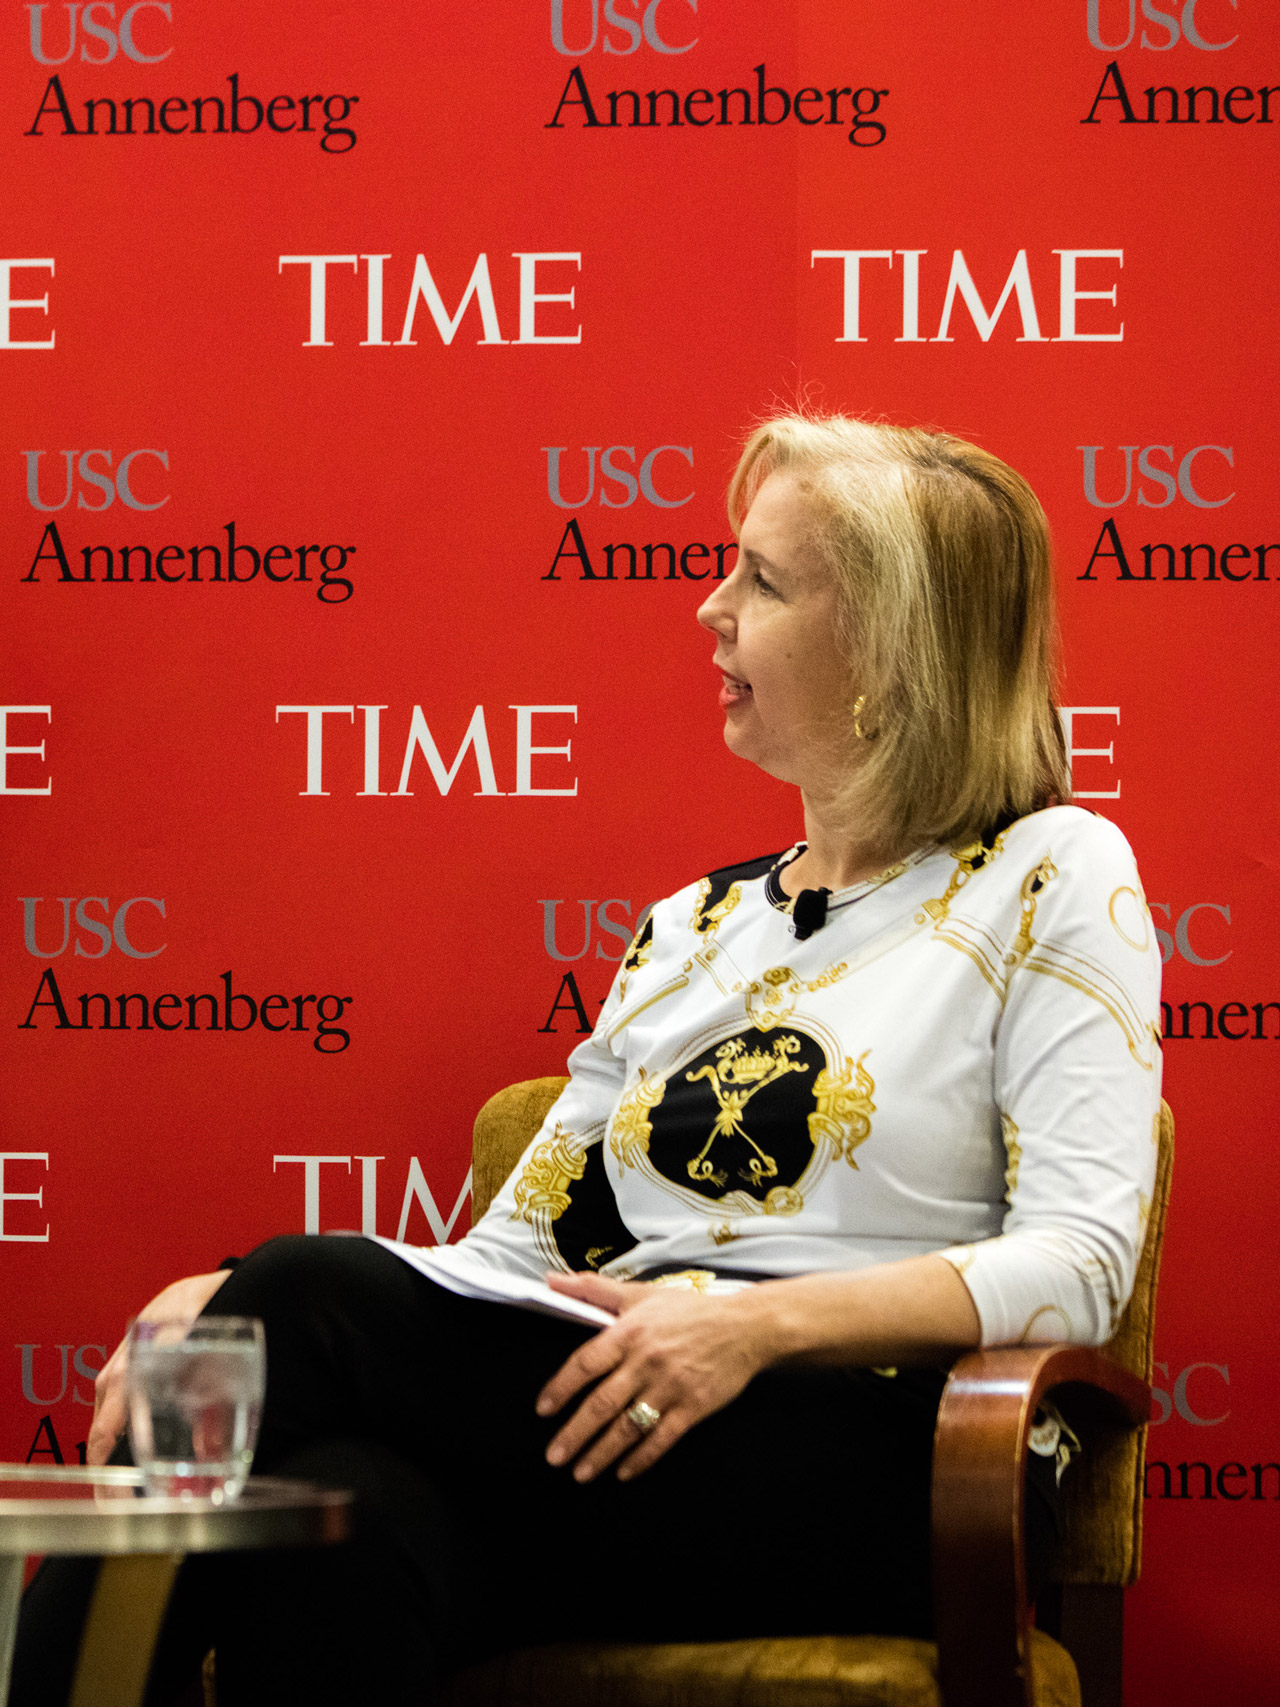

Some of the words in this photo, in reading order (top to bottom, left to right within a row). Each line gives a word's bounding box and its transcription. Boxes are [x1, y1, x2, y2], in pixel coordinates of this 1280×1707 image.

[23, 1, 174, 65] USC
[550, 0, 700, 56] USC
[24, 73, 359, 154] Annenberg
[544, 65, 889, 147] Annenberg
[279, 252, 581, 347] TIME
[811, 249, 1124, 342] TIME
[22, 449, 171, 512] USC
[541, 445, 695, 508] USC
[1076, 445, 1235, 508] USC
[21, 520, 356, 603] Annenberg
[275, 704, 578, 796] TIME
[18, 896, 167, 959] USC
[537, 898, 663, 961] US
[17, 967, 353, 1054] Annenberg
